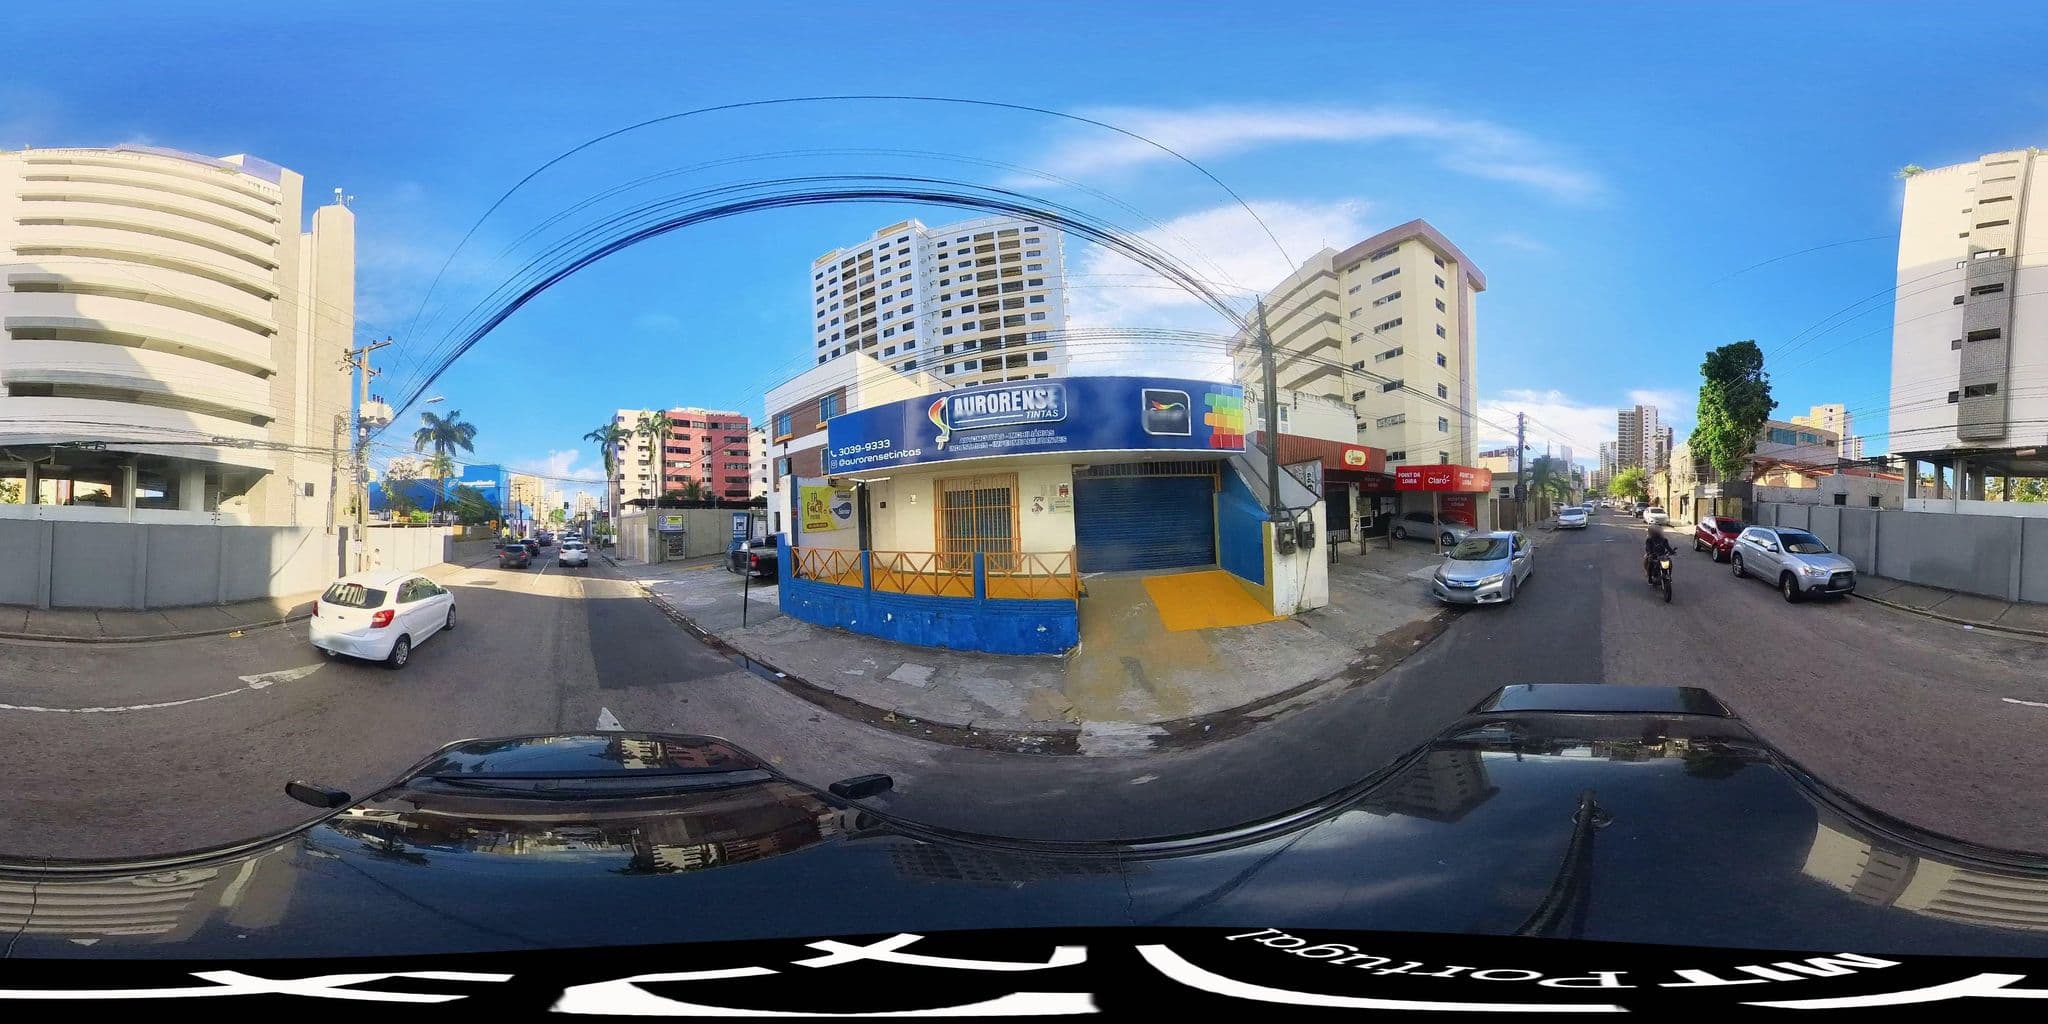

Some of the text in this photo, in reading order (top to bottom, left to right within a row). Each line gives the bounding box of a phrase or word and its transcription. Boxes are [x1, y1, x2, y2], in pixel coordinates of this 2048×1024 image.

[954, 388, 1058, 417] AURORENSE
[1026, 409, 1059, 419] TINTAS
[838, 439, 890, 457] 3039-9333
[839, 448, 921, 467] @aurorensetintas
[1428, 475, 1448, 484] Claro
